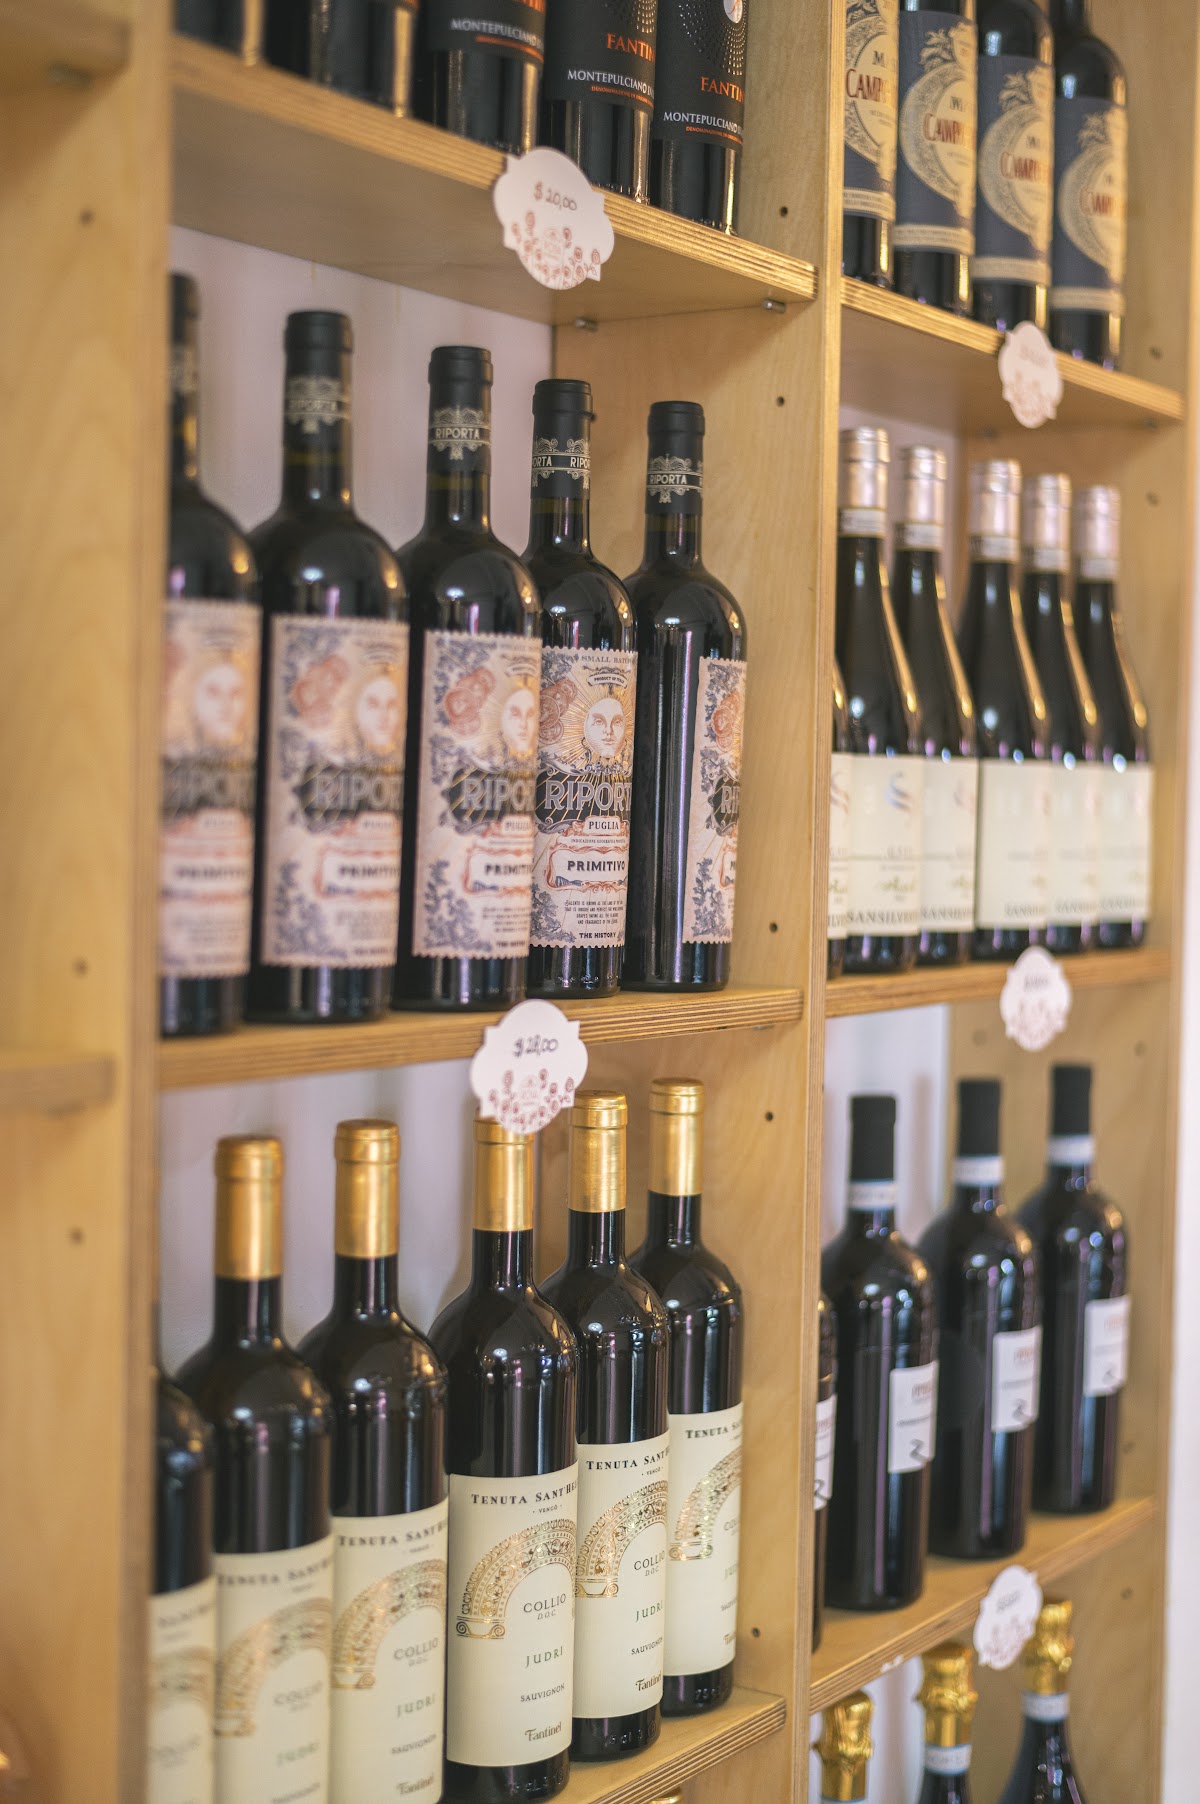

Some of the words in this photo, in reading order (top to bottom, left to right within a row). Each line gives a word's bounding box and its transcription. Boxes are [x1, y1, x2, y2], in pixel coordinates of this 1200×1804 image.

[567, 69, 647, 94] MONTEPULCIANO
[663, 111, 737, 133] MONTEPULCIANO
[435, 427, 480, 440] RIPORTA
[649, 474, 688, 485] RIPORTA
[588, 821, 620, 830] PUGLIA
[566, 860, 626, 872] PRIMITIVO
[685, 1426, 729, 1439] TENUTA
[586, 1459, 638, 1470] TENUTA
[471, 1493, 528, 1504] TENUTA
[338, 1535, 398, 1547] TENUTA
[523, 1593, 567, 1614] COLLIO
[393, 1637, 438, 1661] COLLIO
[525, 1646, 564, 1668] JUDRI
[520, 1682, 565, 1702] SAUVIGNON
[524, 1720, 562, 1742] Fantinel
